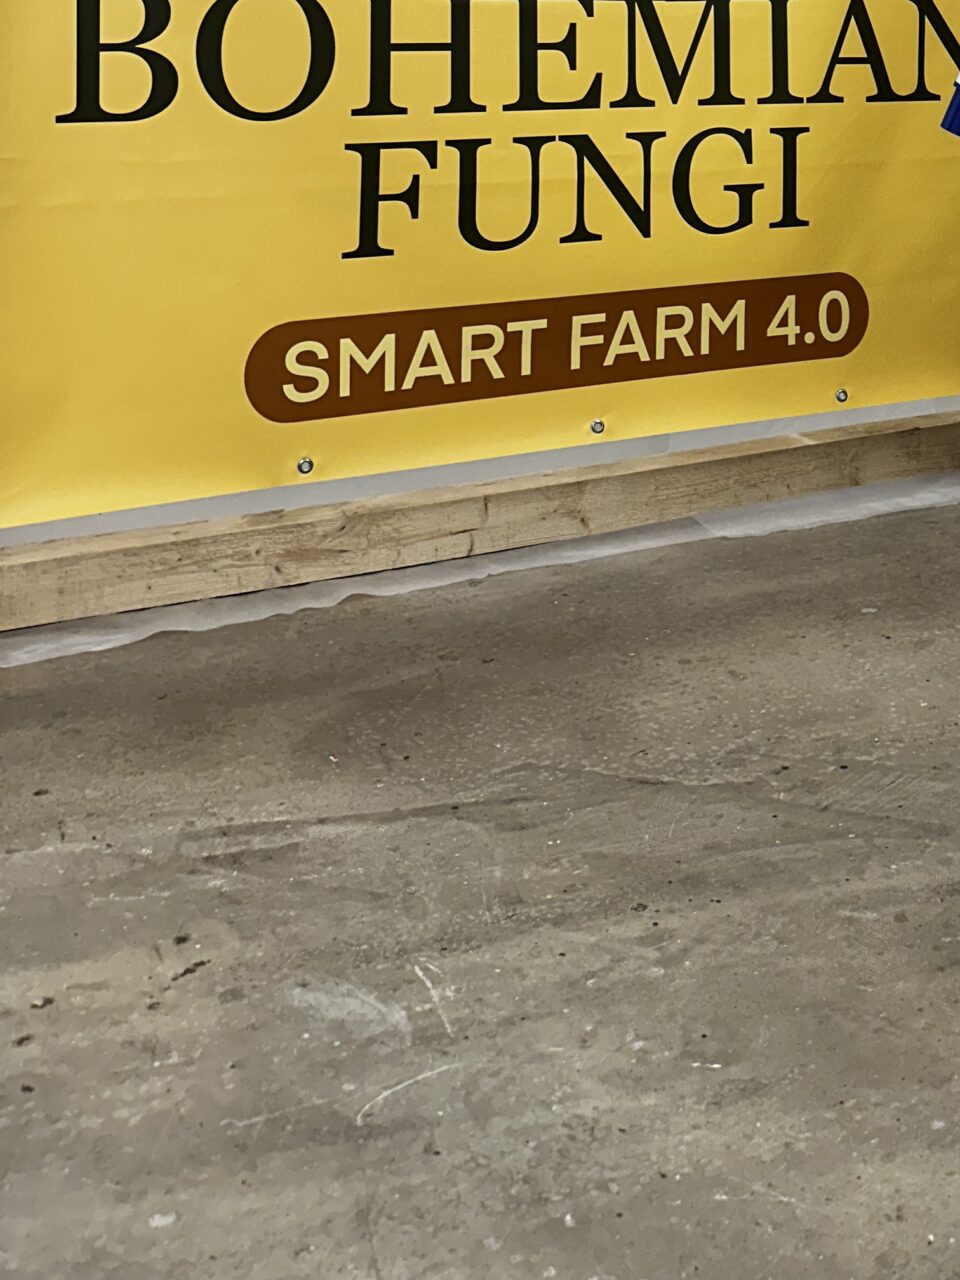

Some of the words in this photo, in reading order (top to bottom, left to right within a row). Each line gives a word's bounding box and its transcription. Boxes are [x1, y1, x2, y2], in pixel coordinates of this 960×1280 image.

[341, 125, 810, 260] FUNGI
[282, 318, 548, 403] SMART
[570, 298, 747, 370] FARM
[766, 289, 850, 347] 4.0
